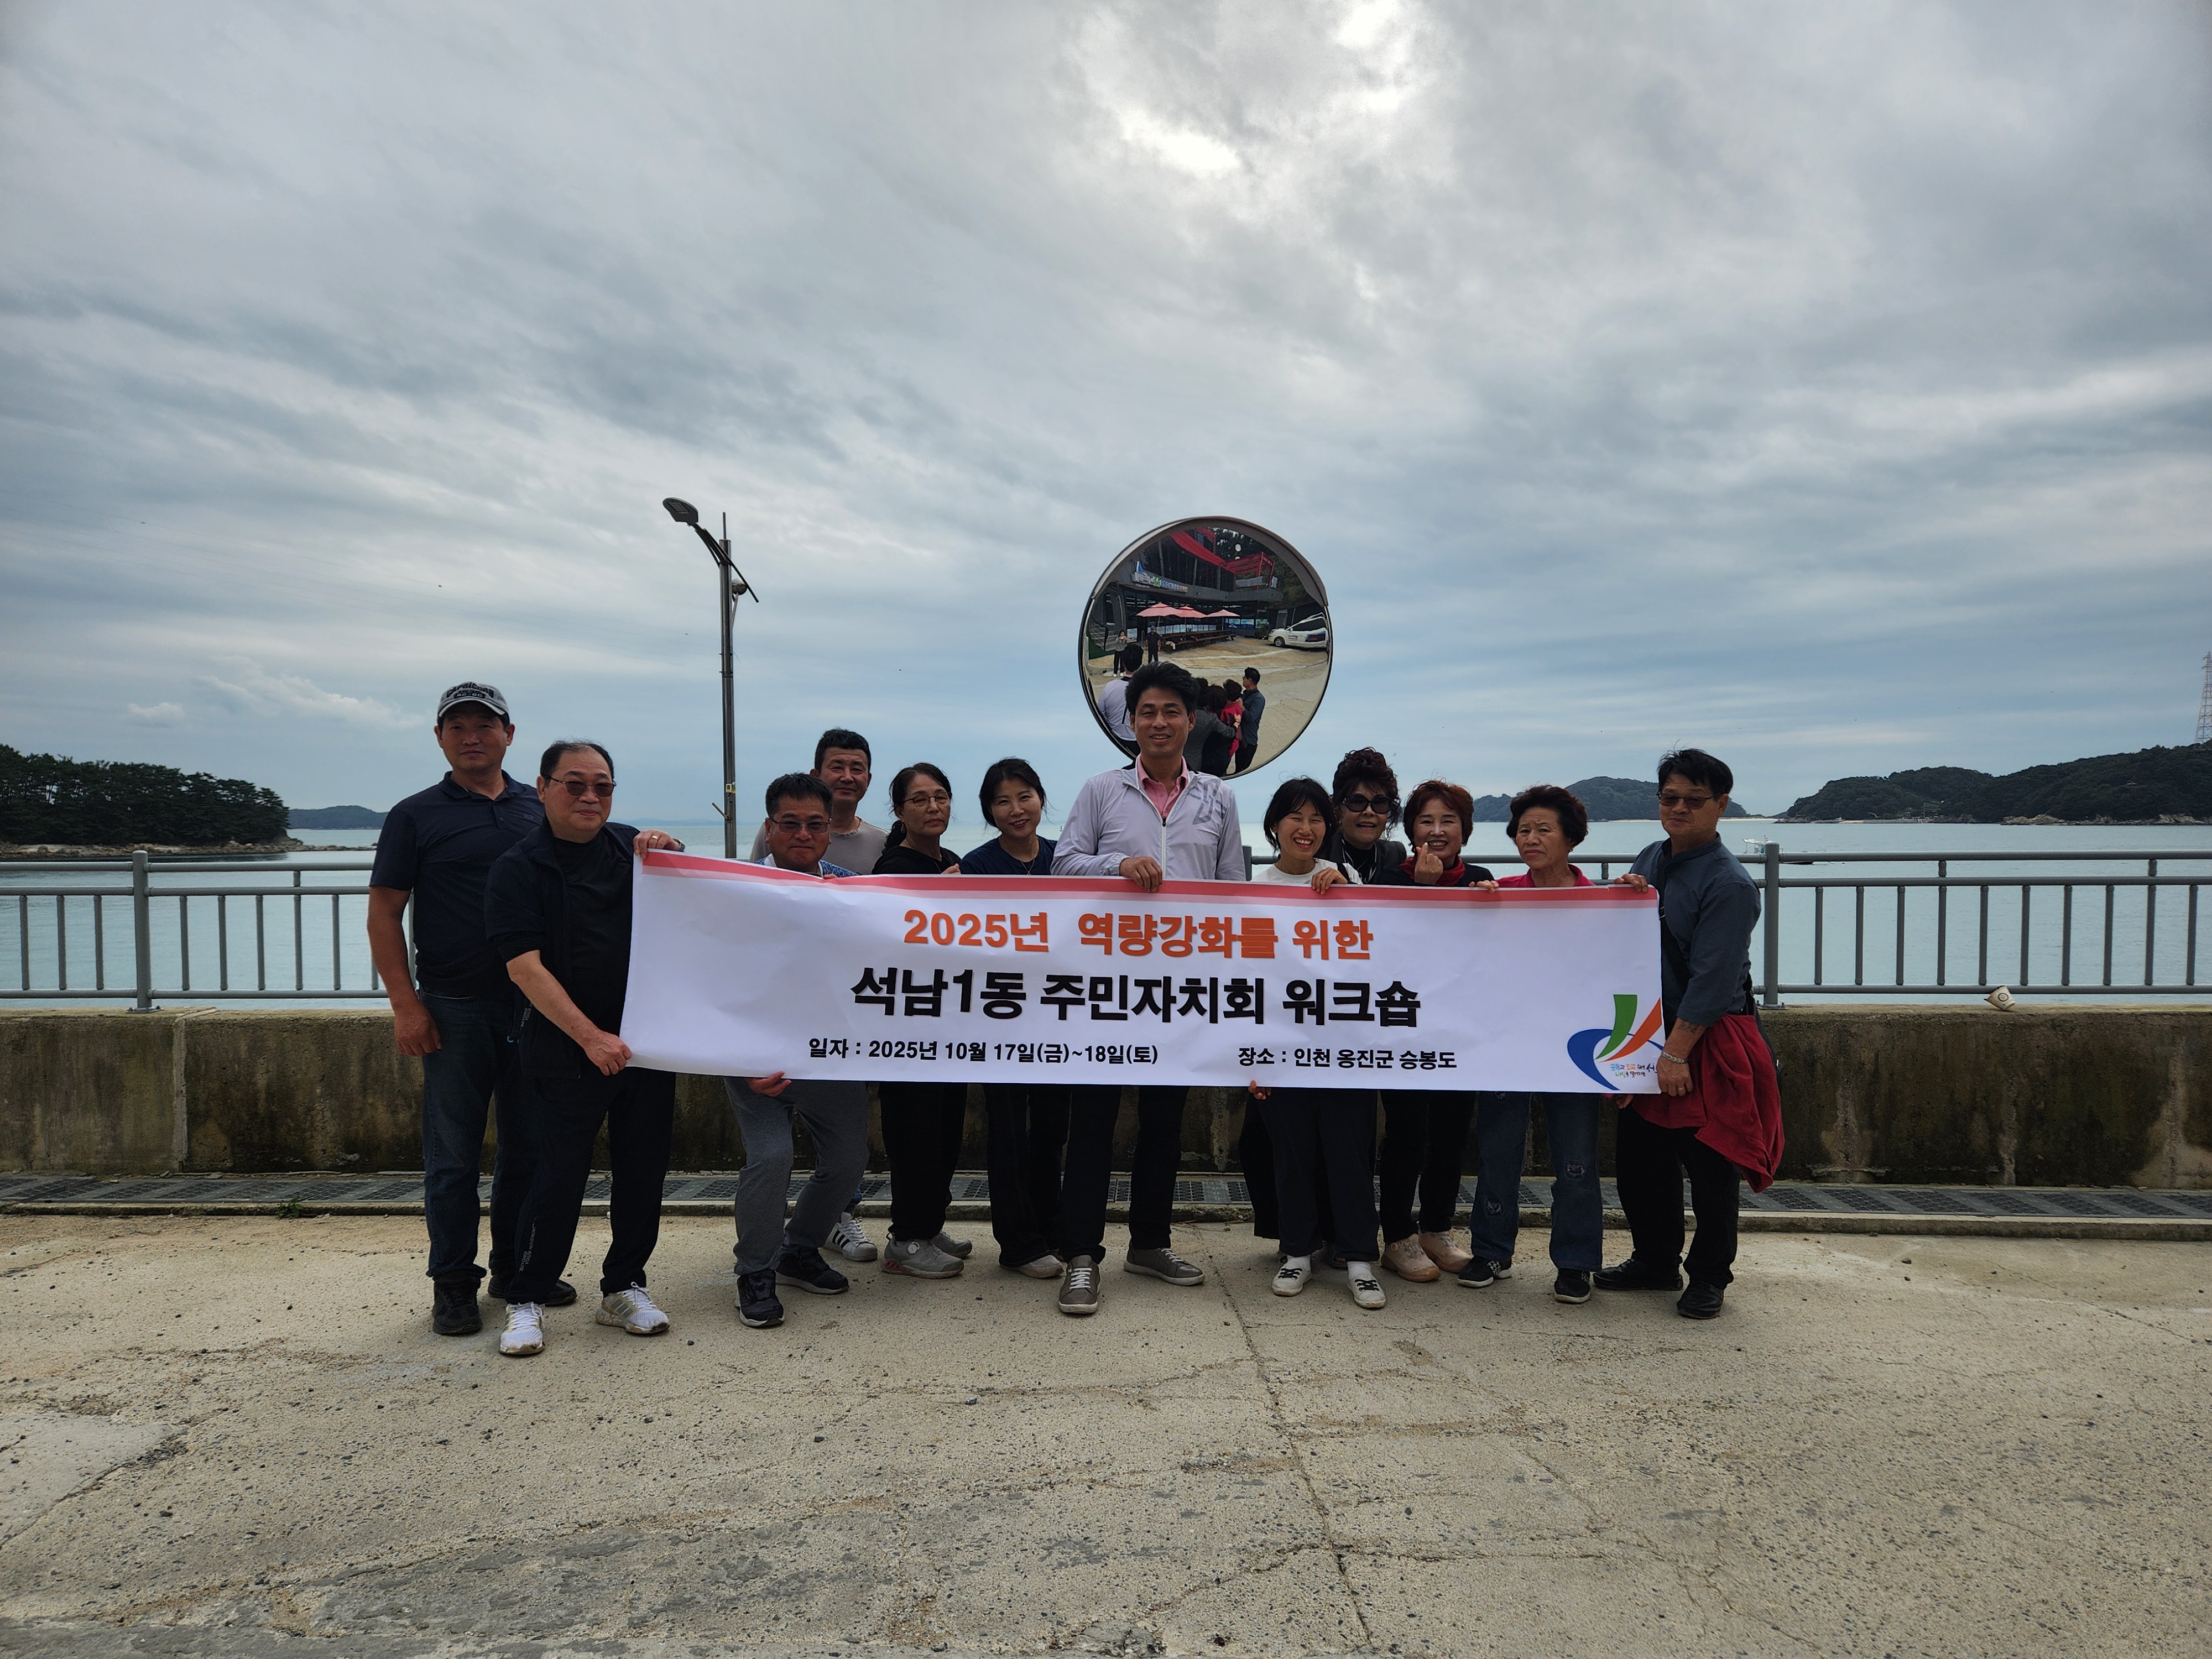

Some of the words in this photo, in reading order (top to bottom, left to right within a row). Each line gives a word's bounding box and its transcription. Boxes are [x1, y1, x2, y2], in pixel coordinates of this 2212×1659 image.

[904, 909, 1049, 952] 2025년
[1078, 912, 1279, 958] 역량강화를
[1292, 919, 1374, 961] 위한
[851, 967, 1027, 1020] 석남1동
[1040, 974, 1264, 1025] 주민자치회
[1282, 979, 1421, 1027] 워크숍
[808, 1038, 849, 1059] 일자
[868, 1040, 938, 1061] 2025년
[945, 1042, 986, 1062] 10월
[993, 1043, 1158, 1065] 17일(금)~18일(토)
[1238, 1047, 1275, 1067] 장소
[1294, 1048, 1331, 1067] 인천
[1337, 1049, 1394, 1069] 옹진군
[1399, 1050, 1457, 1070] 승봉도
[519, 1251, 528, 1271] BEYOND
